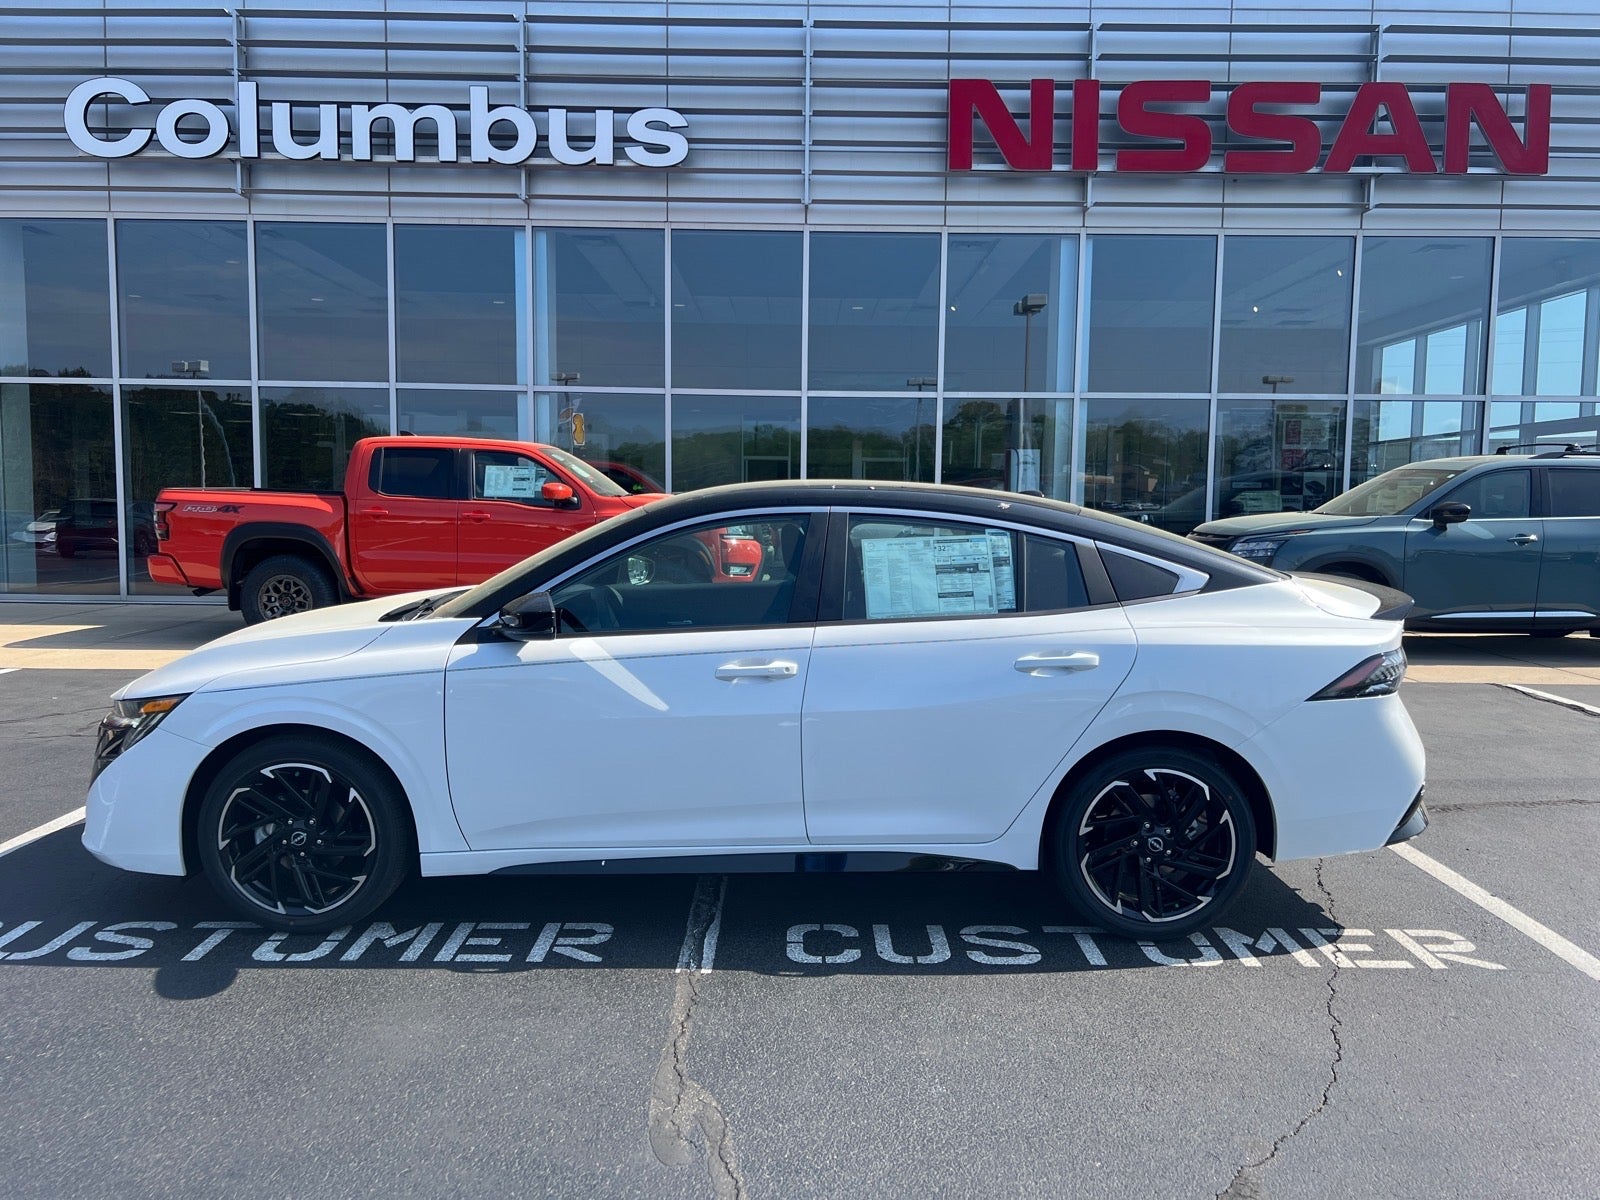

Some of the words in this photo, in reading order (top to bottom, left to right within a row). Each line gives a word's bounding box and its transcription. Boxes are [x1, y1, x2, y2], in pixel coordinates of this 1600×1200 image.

[63, 76, 690, 168] Columbus
[948, 78, 1552, 176] NISSAN
[0, 920, 615, 964] USTOMER
[786, 923, 1508, 970] CUSTOMER
